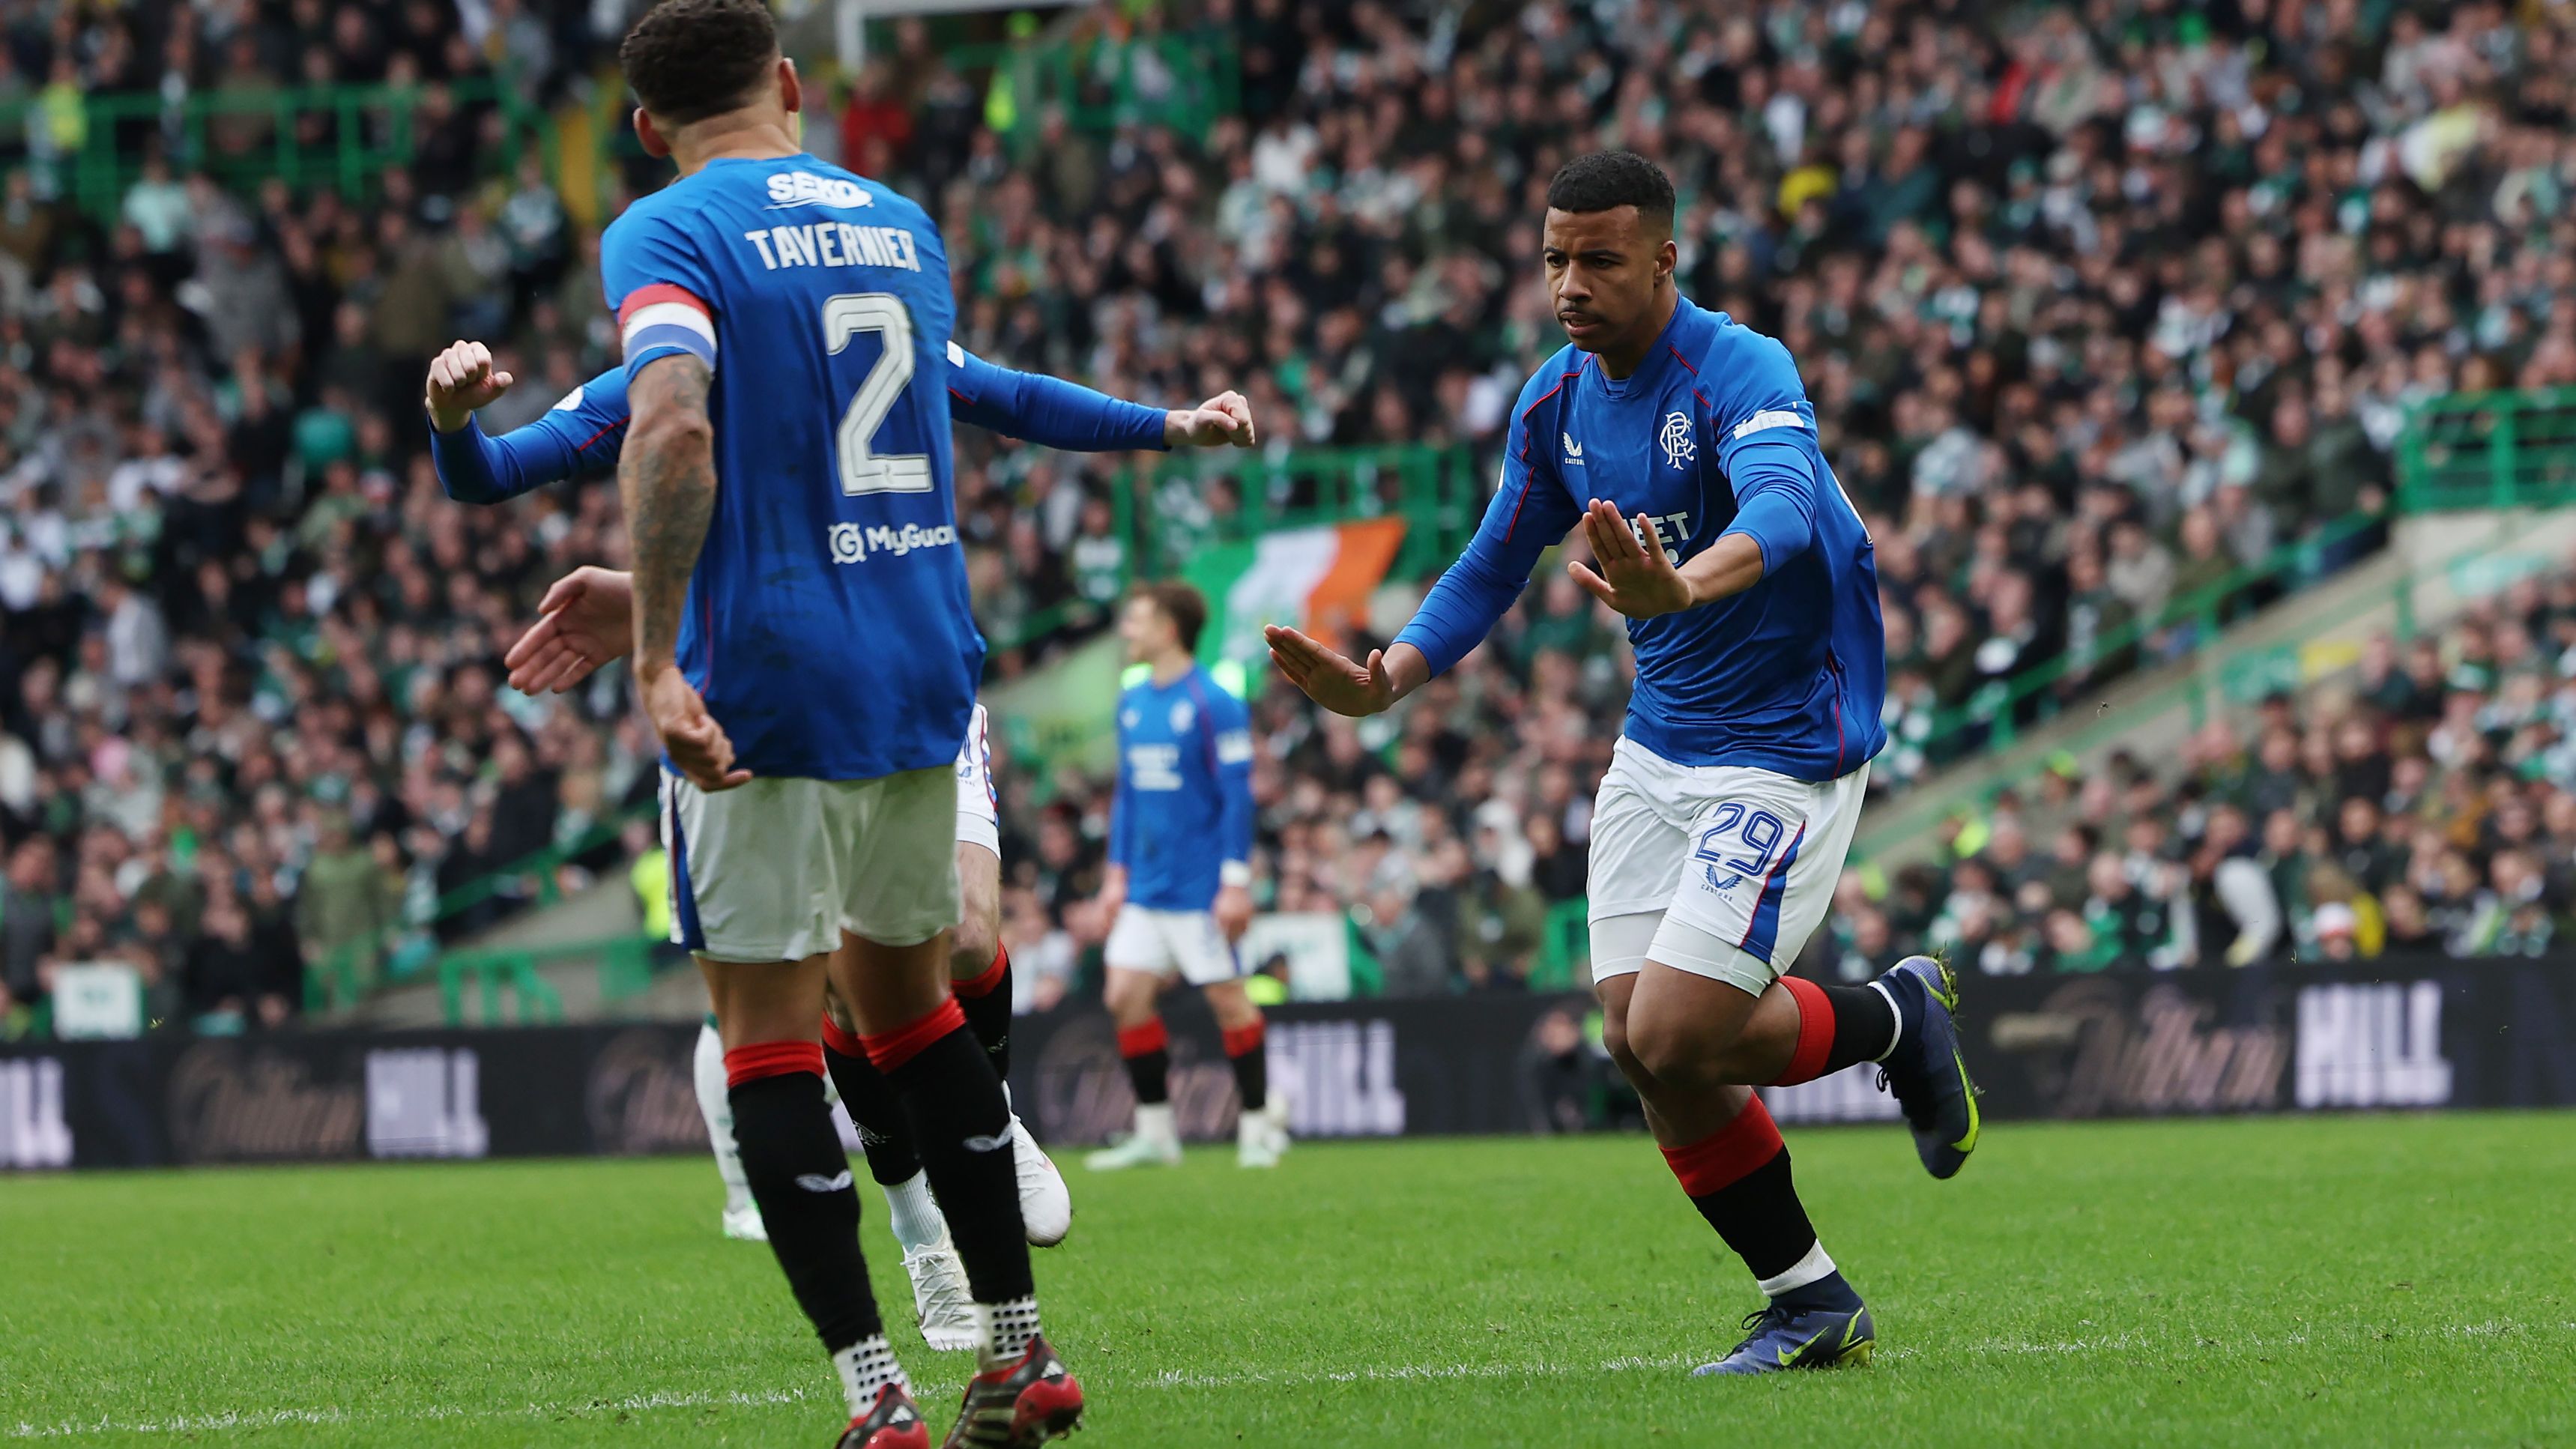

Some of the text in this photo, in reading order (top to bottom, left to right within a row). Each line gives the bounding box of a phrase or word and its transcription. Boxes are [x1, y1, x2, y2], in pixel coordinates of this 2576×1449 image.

[765, 171, 873, 208] SEKO
[745, 222, 922, 273] TAVERNIER
[822, 292, 934, 497] 2
[1694, 802, 1785, 877] 29
[2294, 980, 2453, 1110] HILL
